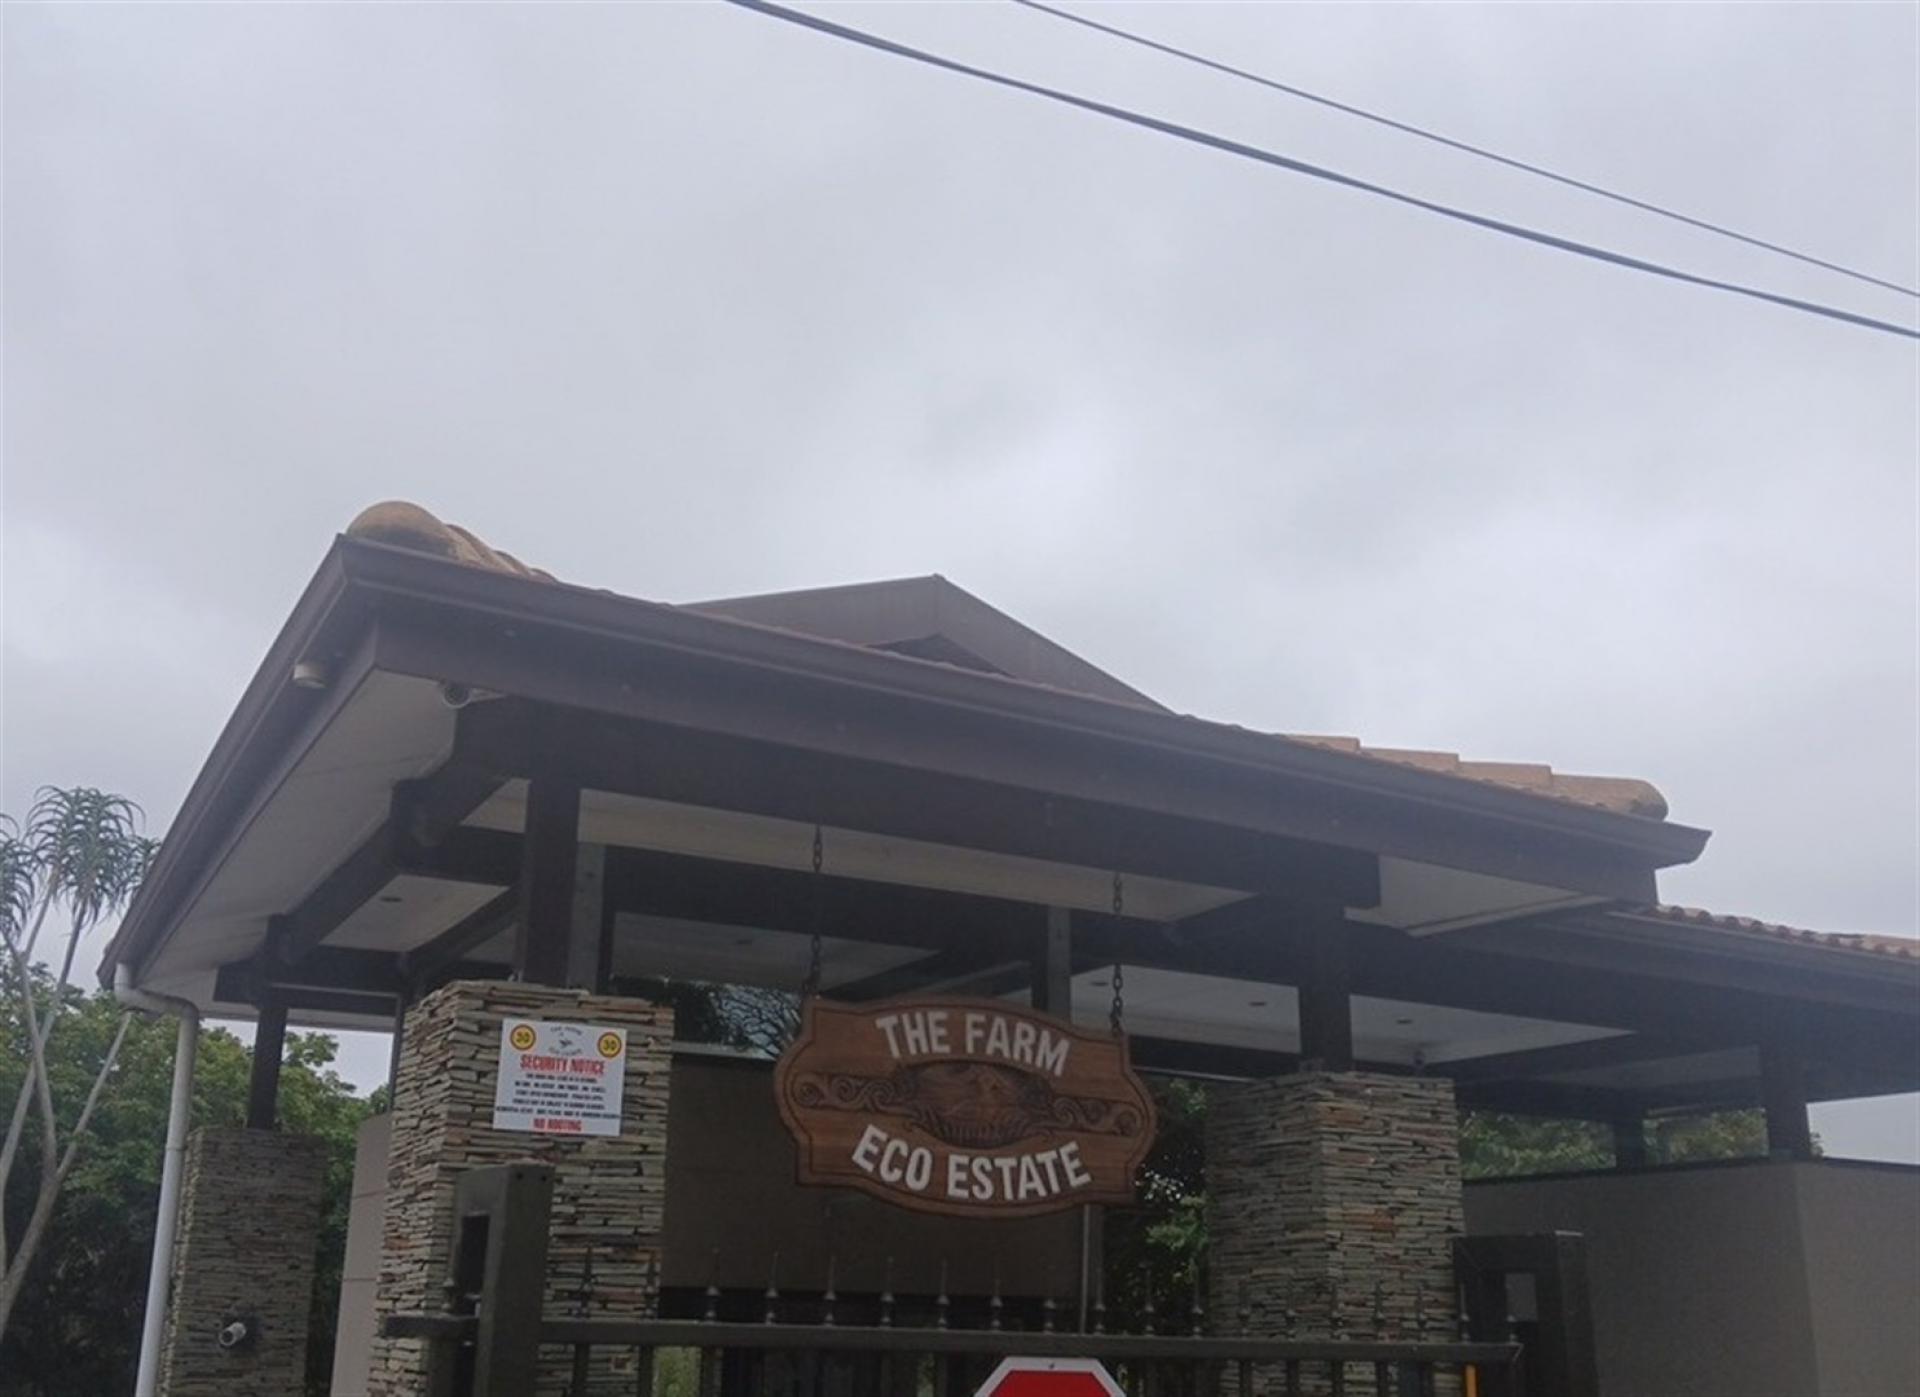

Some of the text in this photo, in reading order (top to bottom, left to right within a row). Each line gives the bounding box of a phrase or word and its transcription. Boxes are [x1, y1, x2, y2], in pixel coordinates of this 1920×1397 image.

[515, 1031, 531, 1043] 30
[603, 1039, 618, 1052] 30
[875, 1012, 1070, 1077] THE FARM
[521, 1054, 604, 1076] SECURITY NOTICE
[533, 1118, 545, 1129] NO
[852, 1124, 1091, 1200] ECO ESTATE
